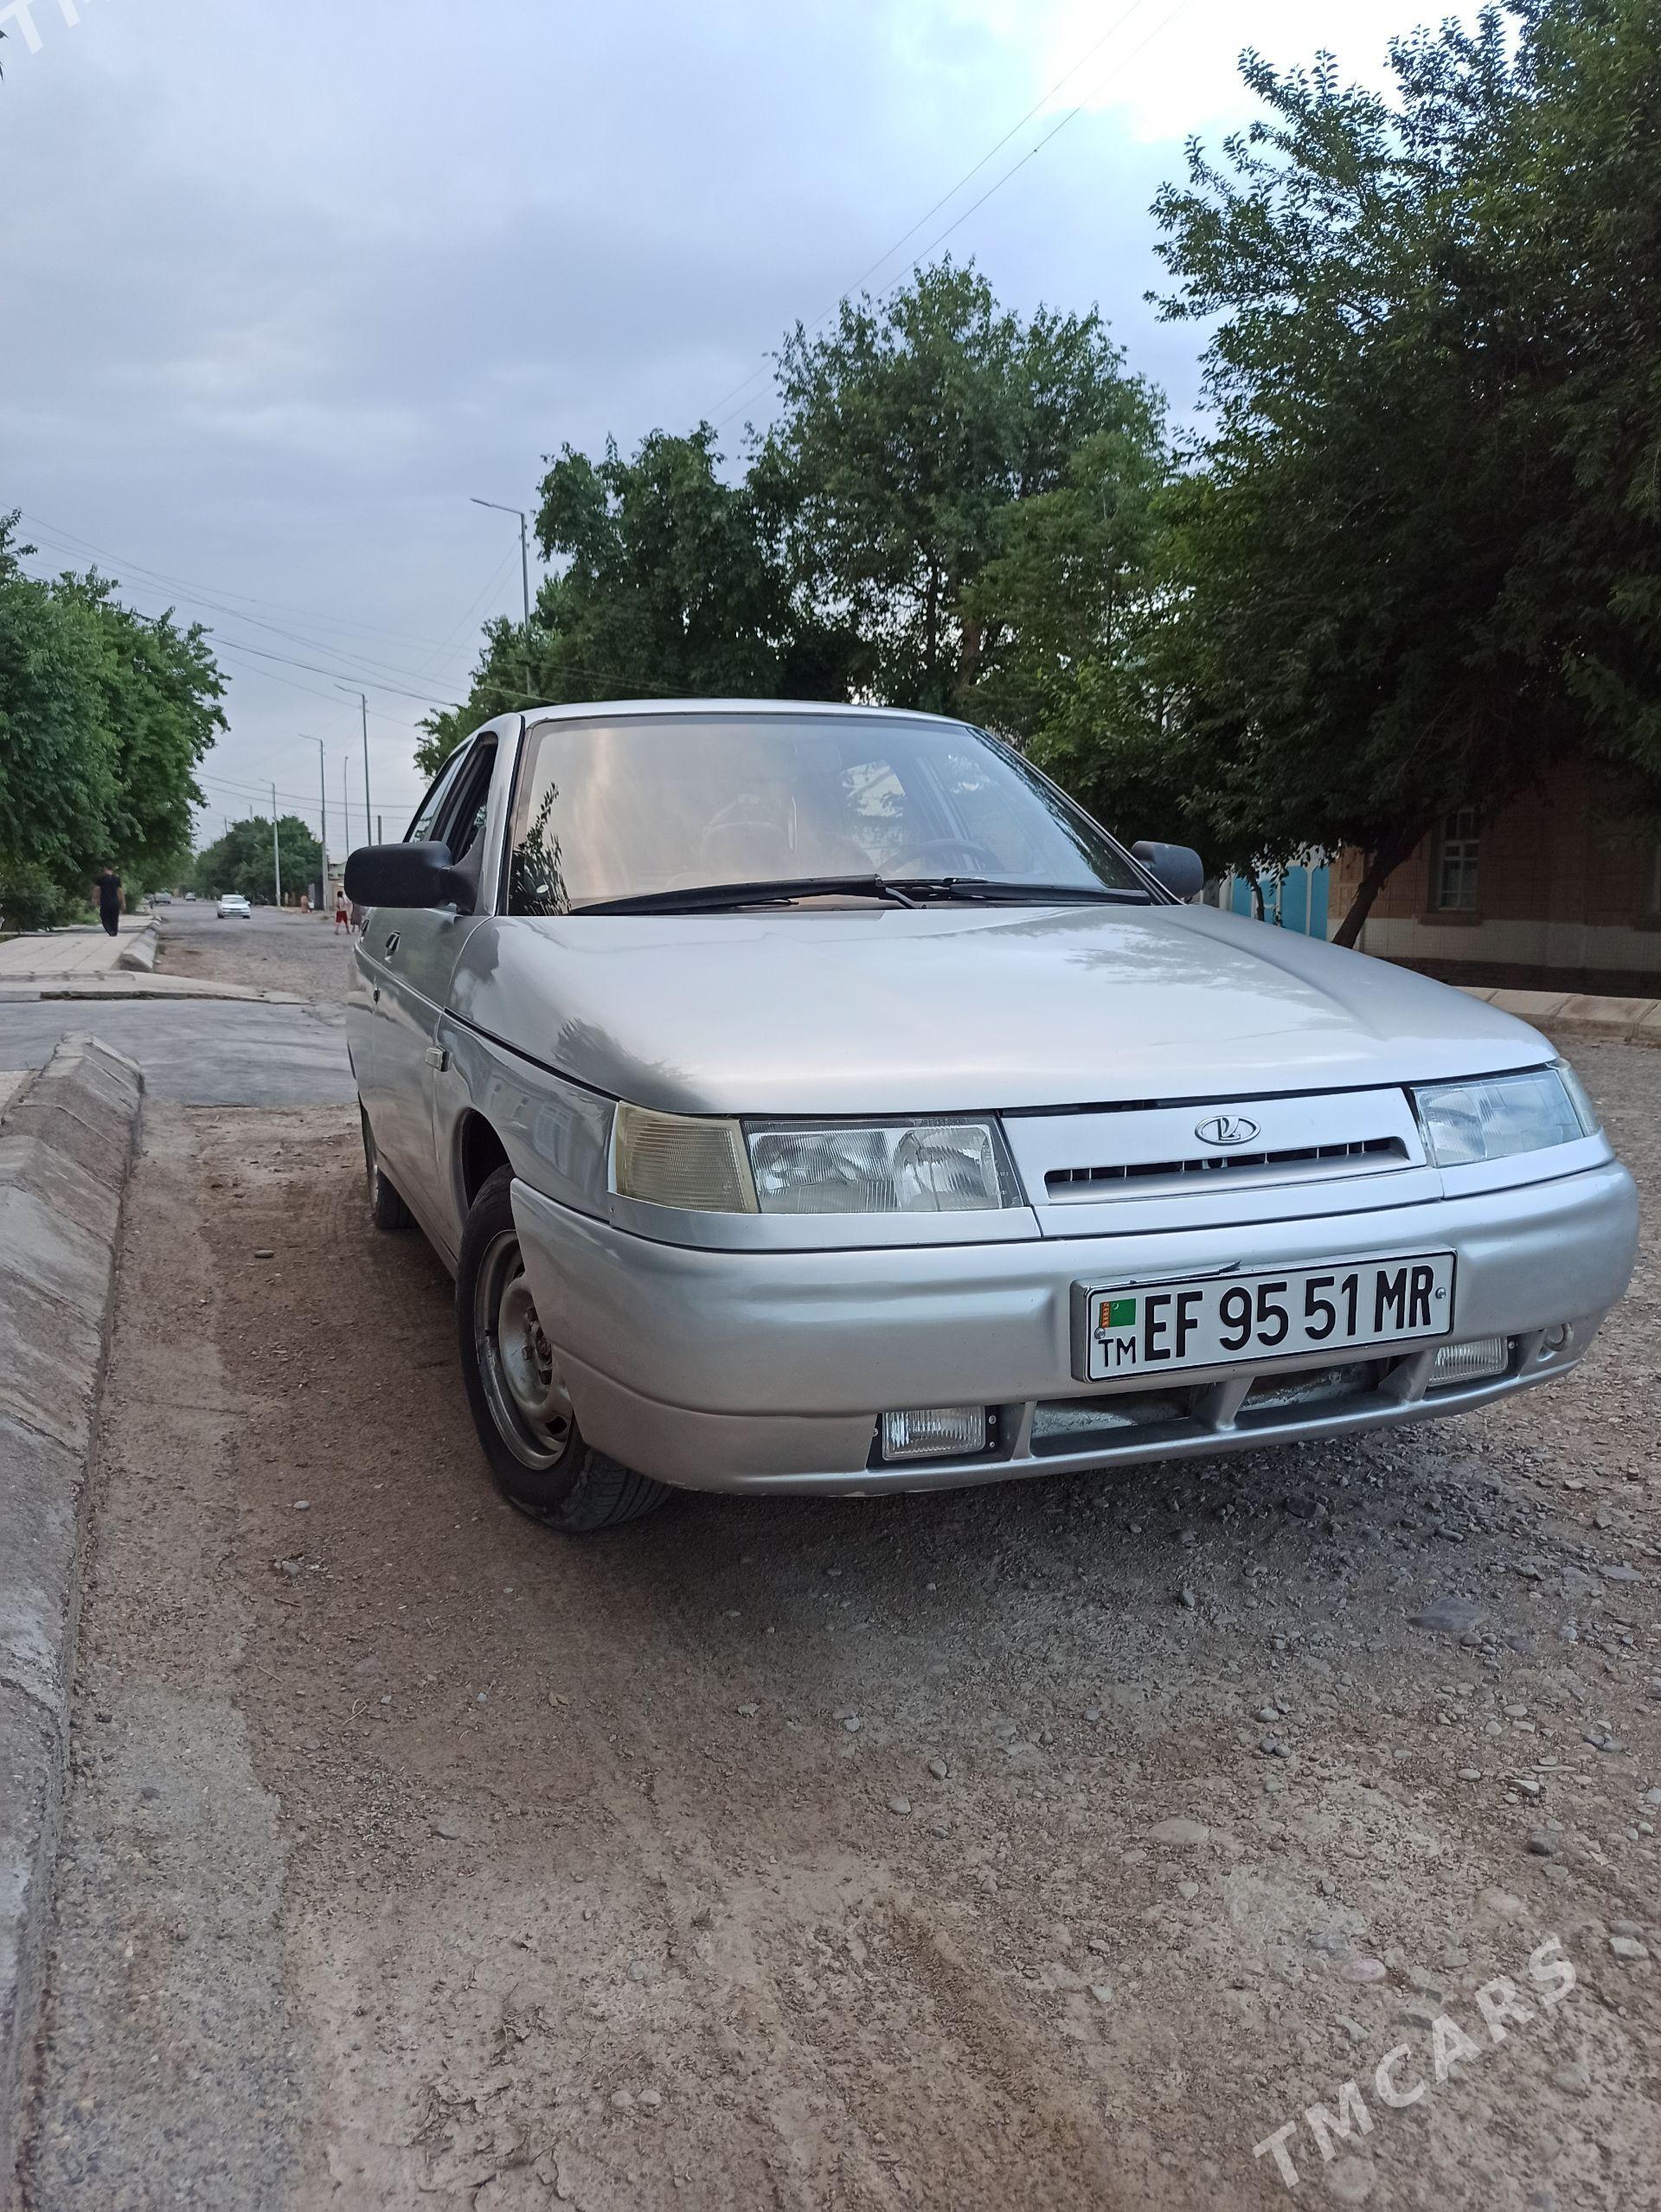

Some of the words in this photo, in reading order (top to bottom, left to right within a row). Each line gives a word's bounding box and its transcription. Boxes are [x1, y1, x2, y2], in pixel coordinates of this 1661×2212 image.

[1145, 1291, 1203, 1361] EF
[1374, 1265, 1434, 1332] MR
[1099, 1336, 1137, 1367] TM
